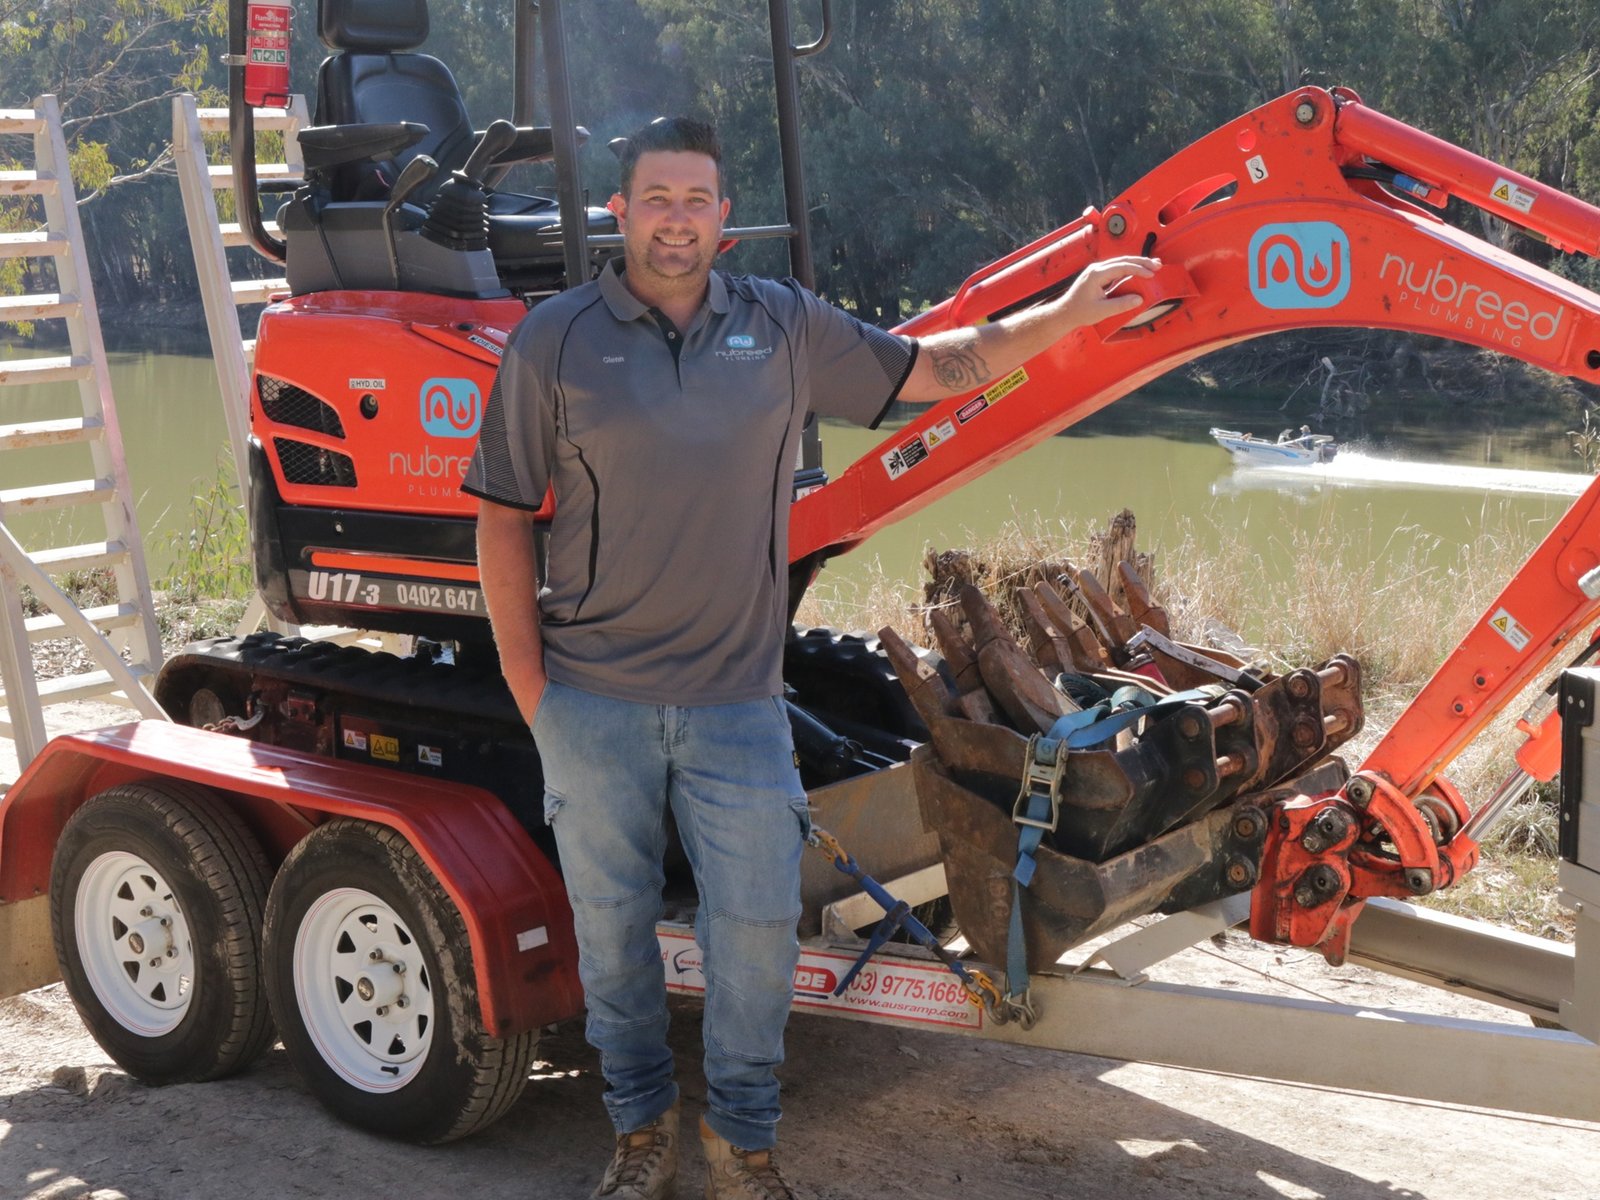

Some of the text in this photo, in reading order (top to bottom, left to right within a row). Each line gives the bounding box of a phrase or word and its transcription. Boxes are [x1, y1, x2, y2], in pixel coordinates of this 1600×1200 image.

[1379, 252, 1564, 341] nubreed
[1399, 292, 1523, 348] PLUMBING
[715, 346, 773, 359] nubreed
[373, 380, 384, 388] OIL
[961, 401, 983, 418] DANGER
[396, 584, 441, 608] 0402
[445, 588, 477, 611] 647
[794, 970, 968, 1005] DE 03) 9775.1669
[844, 994, 969, 1020] www.ausramp.com
